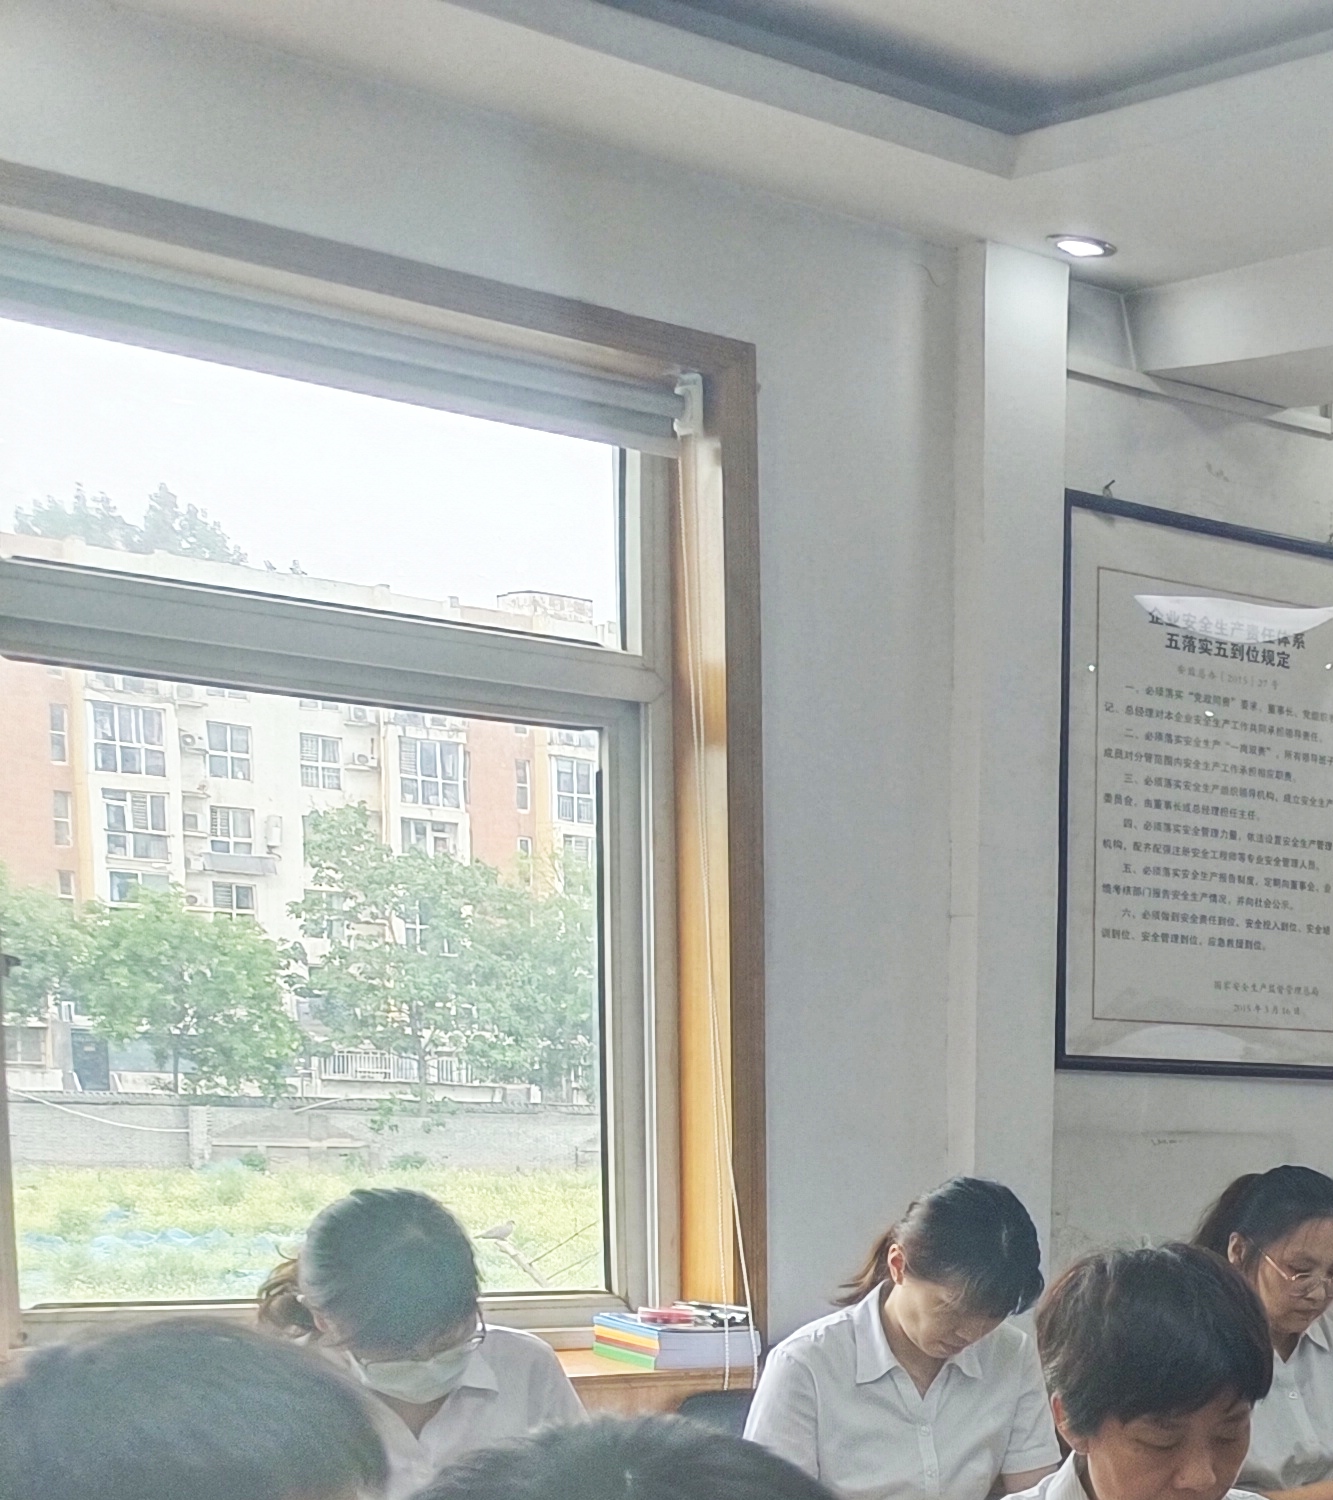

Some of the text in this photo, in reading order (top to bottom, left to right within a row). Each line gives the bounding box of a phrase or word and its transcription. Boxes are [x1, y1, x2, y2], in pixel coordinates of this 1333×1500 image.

[1165, 632, 1292, 669] 五落实五到位规定
